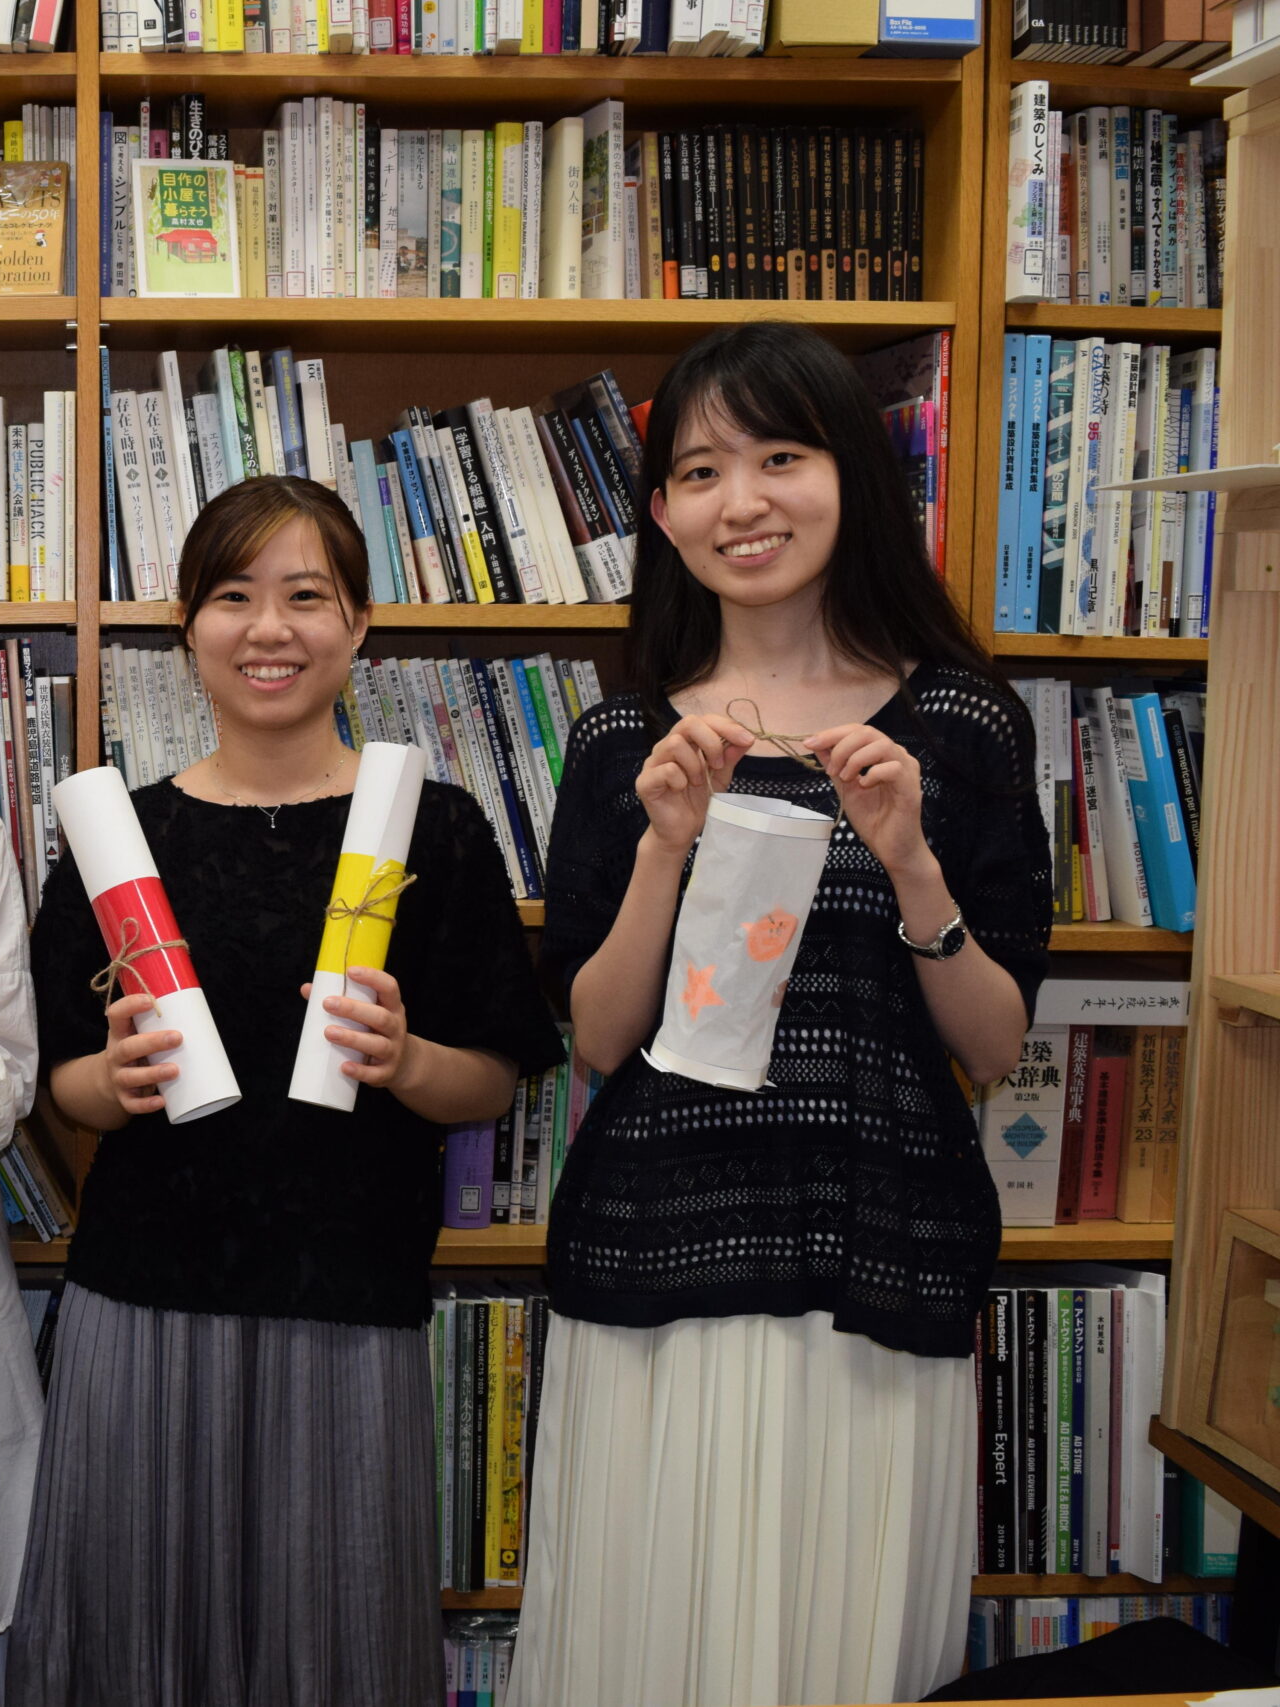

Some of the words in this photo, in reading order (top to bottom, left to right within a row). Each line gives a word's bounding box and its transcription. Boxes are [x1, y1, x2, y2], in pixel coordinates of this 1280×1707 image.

[189, 9, 197, 19] 6
[1031, 19, 1045, 27] GA
[680, 133, 691, 181] 私と日本建築
[1031, 93, 1048, 176] 建築のしくみ
[1097, 117, 1108, 161] 建築計画
[1113, 116, 1129, 181] 建築計画
[161, 171, 206, 188] 自作の
[162, 187, 207, 203] 小屋で
[367, 147, 377, 215] 裸足で逃げる
[567, 165, 580, 216] 街の人生
[163, 202, 208, 218] 暮らそう
[1149, 139, 1163, 289] 地震のすべてがわかる本
[250, 364, 265, 410] 住宅巡礼
[1007, 377, 1018, 421] コンパクト
[1032, 378, 1043, 422] コンパクト
[1128, 353, 1140, 410] 建築設計資料
[116, 397, 139, 467] 存在と時間
[144, 397, 167, 467] 存在と時間
[1004, 420, 1016, 491] 建築設計資料集成
[1028, 422, 1041, 493] 建築設計資料集成
[1087, 422, 1100, 441] 95
[11, 426, 25, 518] 未来住まい方会議
[29, 439, 45, 493] PUBLIC
[453, 426, 497, 549] 「学習する組織」入門
[567, 447, 601, 521] ディスタンクシオン
[30, 498, 47, 542] HACK
[1088, 558, 1099, 613] 黒川紀章
[39, 684, 53, 768] 世界の民族衣装図鑑
[26, 715, 42, 806] 鹿児島県道路地図
[1079, 724, 1098, 811] 吉阪隆正の迷宮
[1171, 723, 1183, 747] case
[1177, 747, 1194, 797] americane
[1132, 841, 1149, 899] MODERNISM
[1014, 1092, 1040, 1102] 第2版
[1066, 1032, 1089, 1124] 建築英語事典
[1137, 1033, 1157, 1123] 新建築学大系
[1160, 1037, 1181, 1125] 新建築学大系
[1135, 1128, 1153, 1141] 23
[1159, 1129, 1177, 1142] 29
[996, 1295, 1007, 1363] Panasonic
[1060, 1420, 1070, 1435] AD
[1060, 1437, 1071, 1472] EUROPE
[1074, 1435, 1083, 1447] AD
[992, 1432, 1008, 1486] Expert
[1060, 1474, 1071, 1493] TILE
[1074, 1448, 1083, 1475] STONE
[1060, 1502, 1071, 1533] BRICK
[997, 1525, 1006, 1569] 2018-2019
